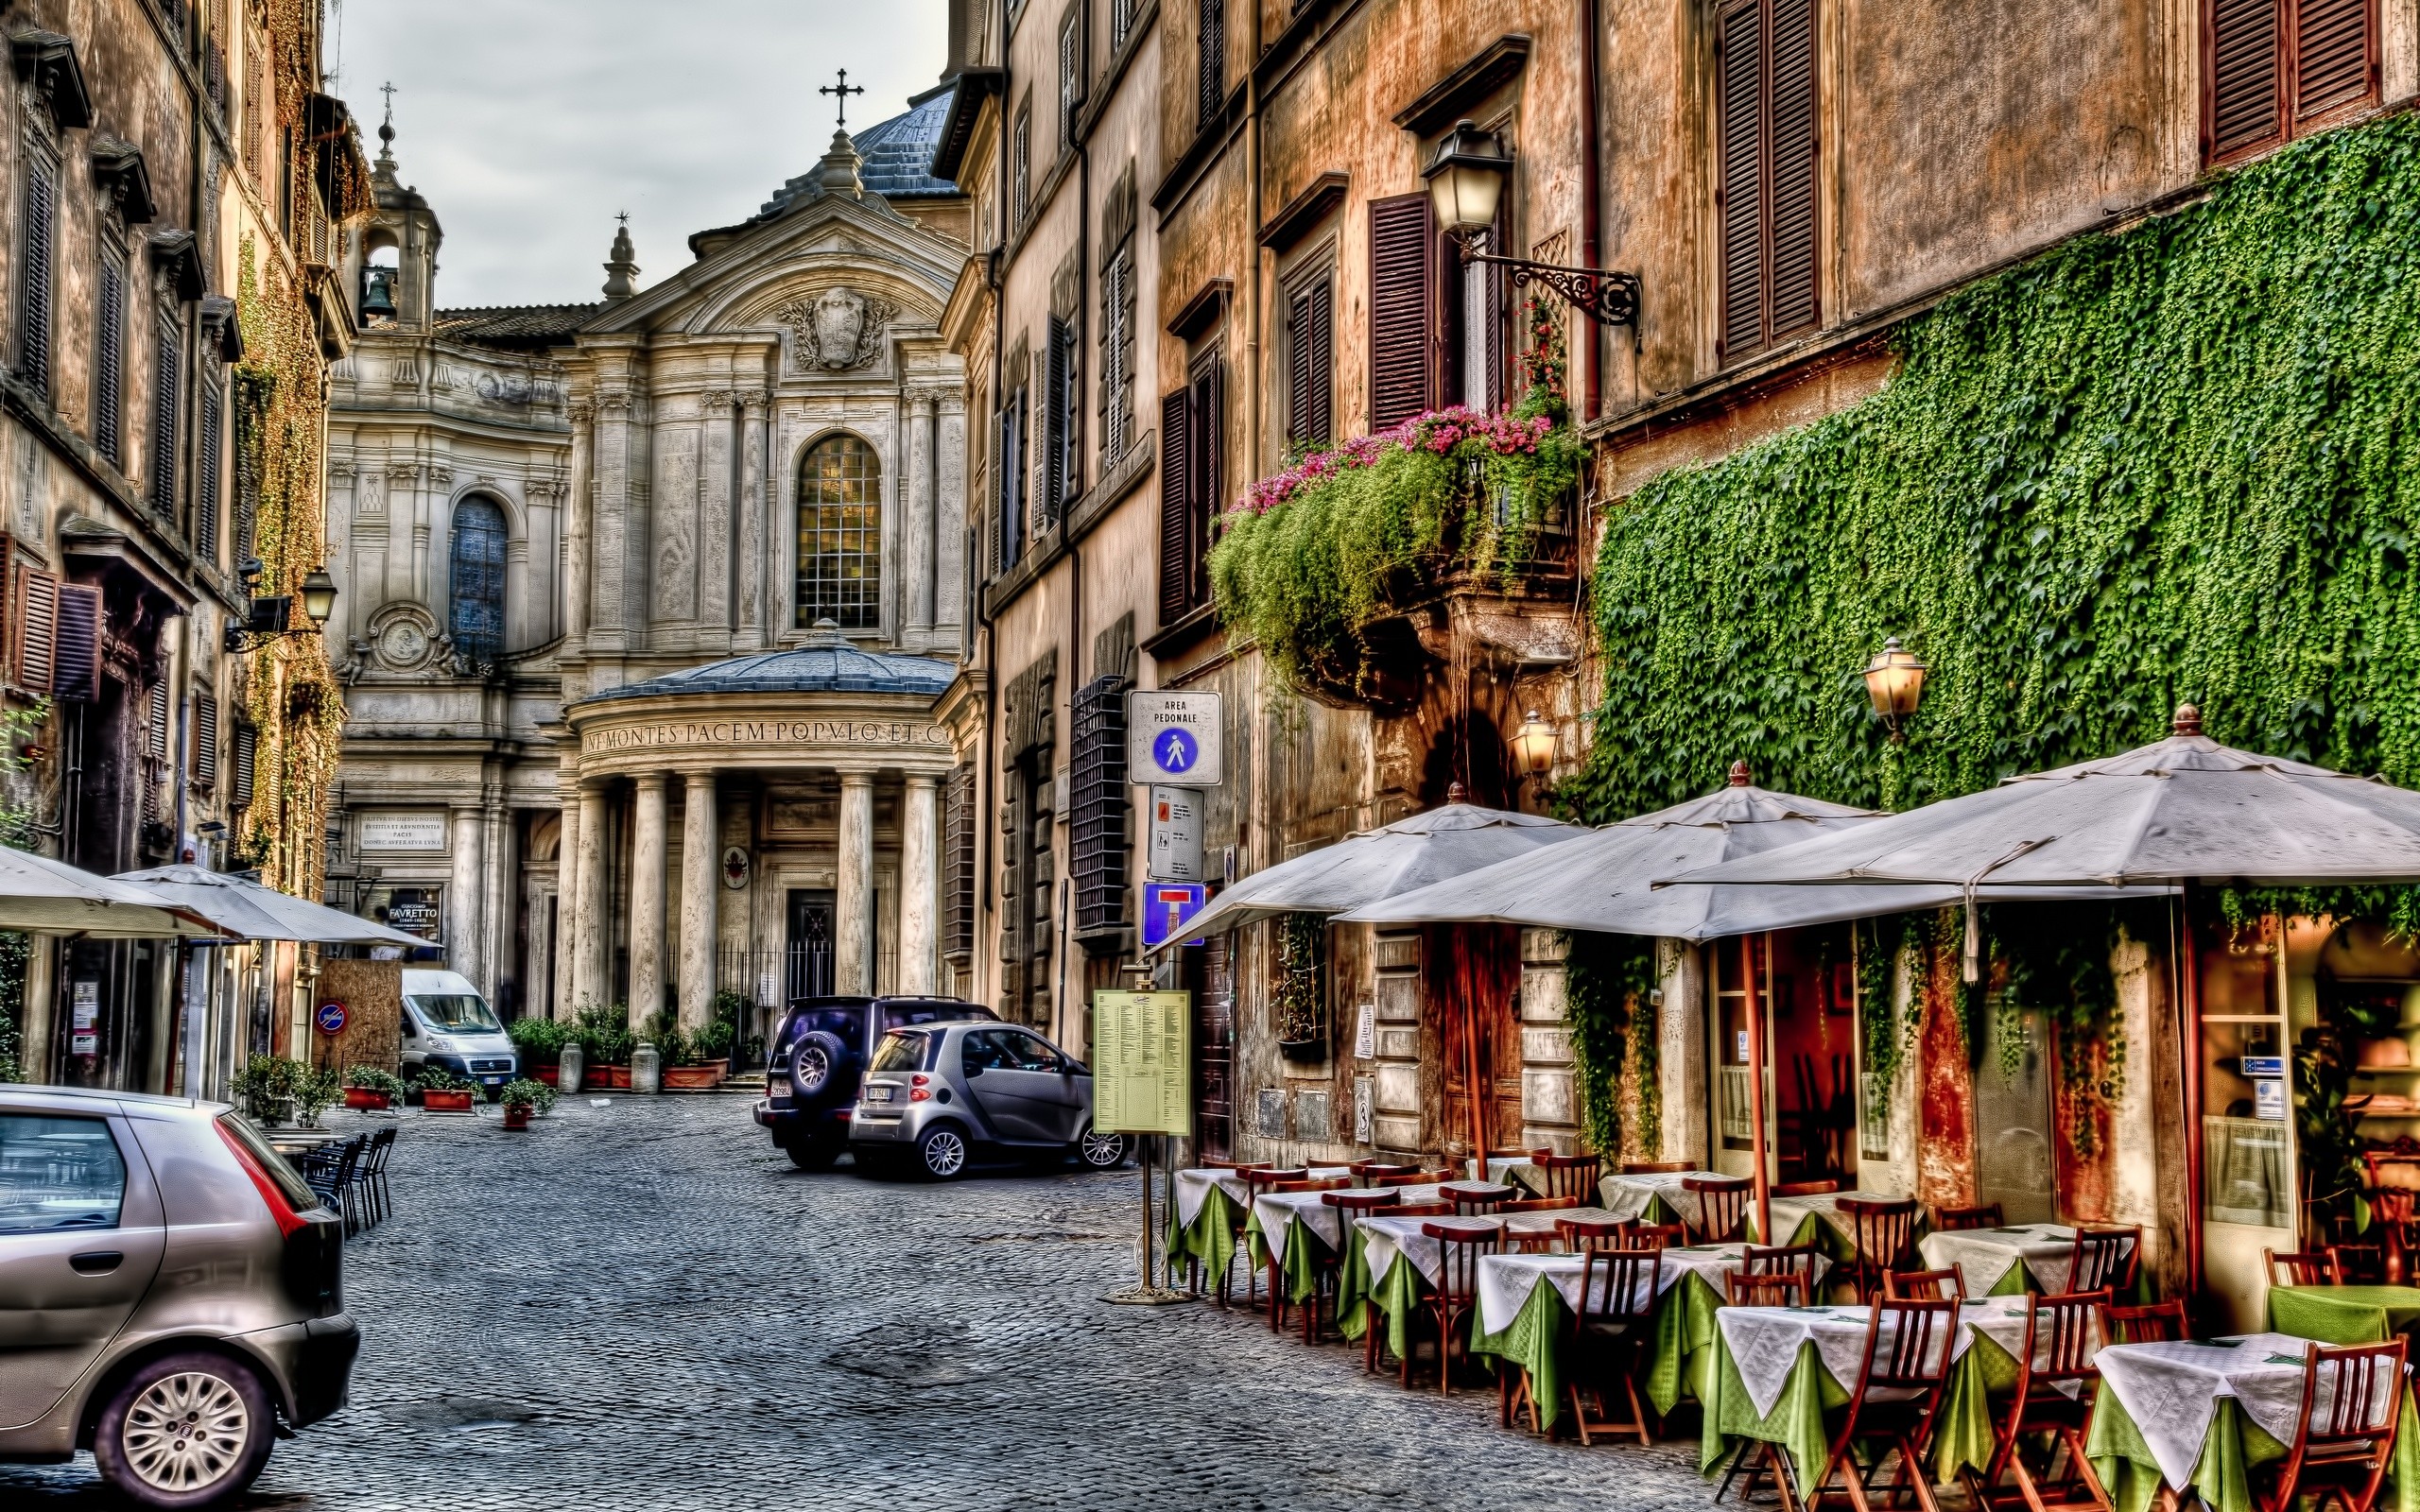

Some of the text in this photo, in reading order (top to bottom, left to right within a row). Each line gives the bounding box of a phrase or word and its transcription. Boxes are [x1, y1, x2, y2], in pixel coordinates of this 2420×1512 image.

[1165, 700, 1187, 711] AREA
[1154, 713, 1198, 724] PEDONALE
[606, 725, 678, 749] MONTES
[685, 722, 766, 743] PACEM
[776, 722, 879, 741] POPVLO
[890, 724, 919, 742] ET
[389, 908, 438, 919] FAVRETTO
